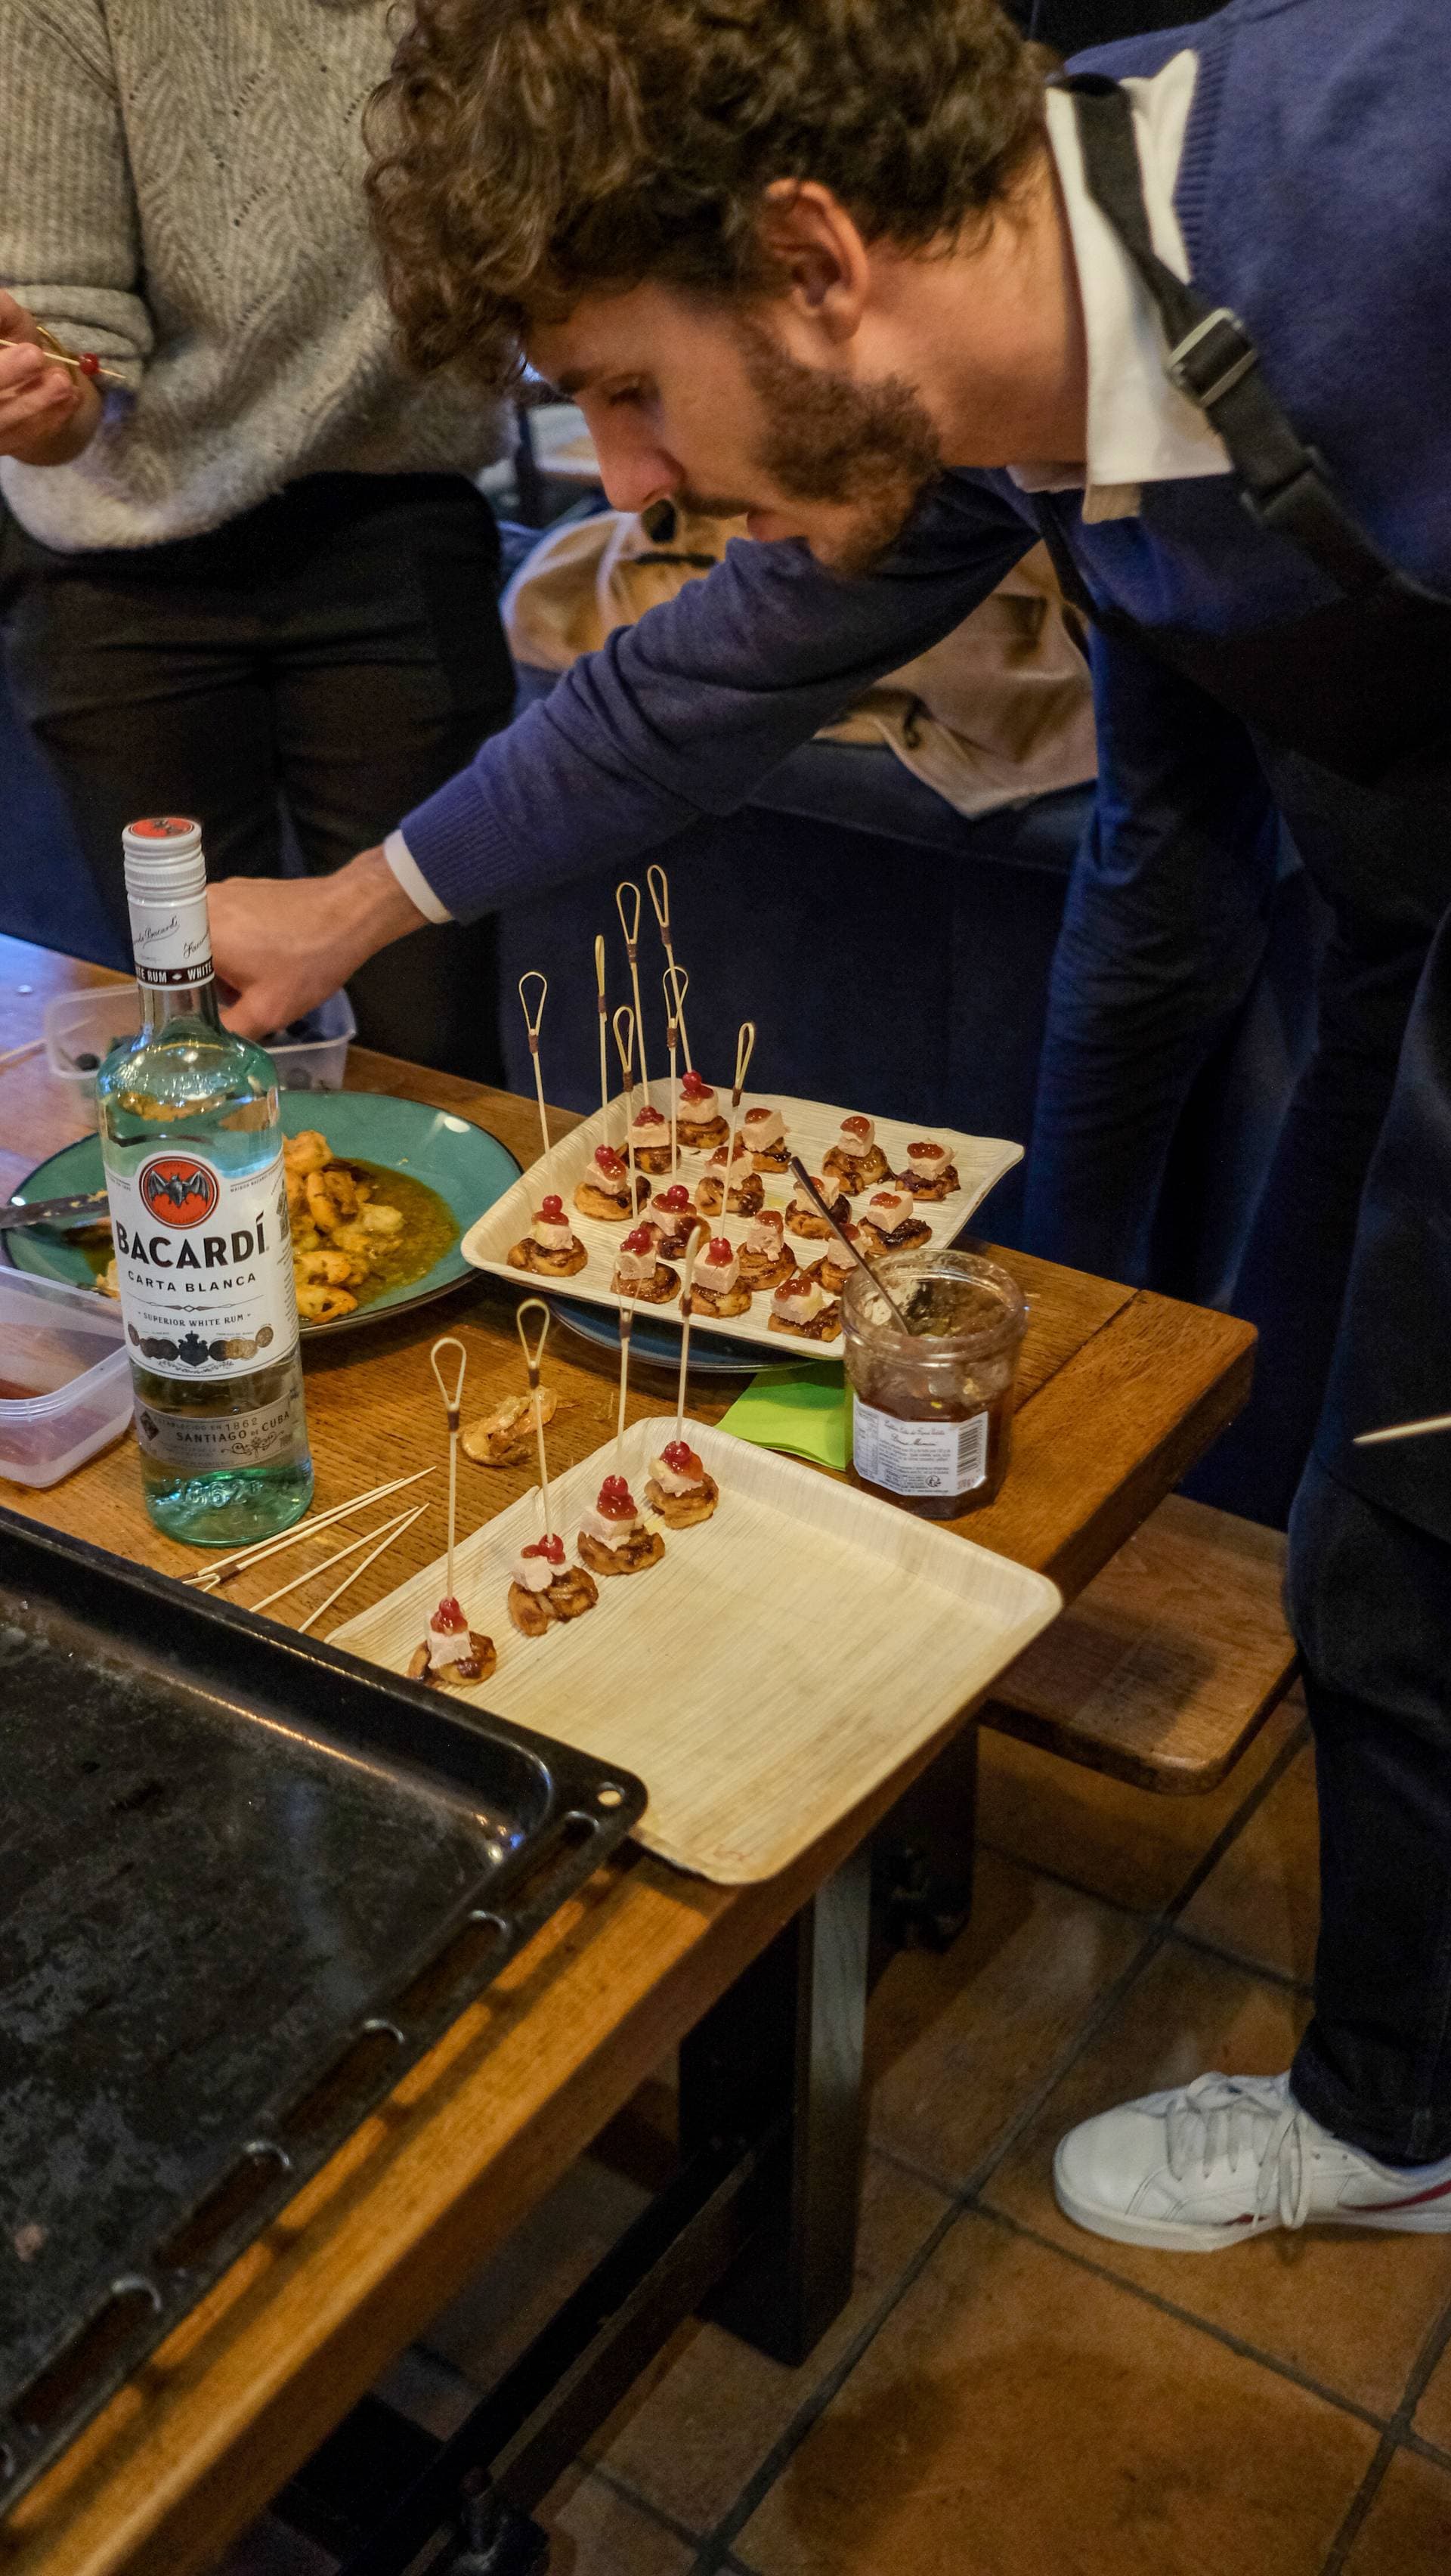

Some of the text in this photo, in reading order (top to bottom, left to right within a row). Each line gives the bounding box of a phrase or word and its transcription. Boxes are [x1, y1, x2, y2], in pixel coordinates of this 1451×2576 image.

[147, 969, 167, 983] RUM
[187, 962, 212, 980] WHITE
[116, 1210, 266, 1269] BACARDÍ
[128, 1270, 256, 1293] CARTA BLANCA
[144, 1312, 243, 1327] SUPERIOR WHITE RUM
[176, 1429, 247, 1443] SANTIAGO
[261, 1411, 289, 1432] CUBA
[226, 1416, 258, 1431] 1862
